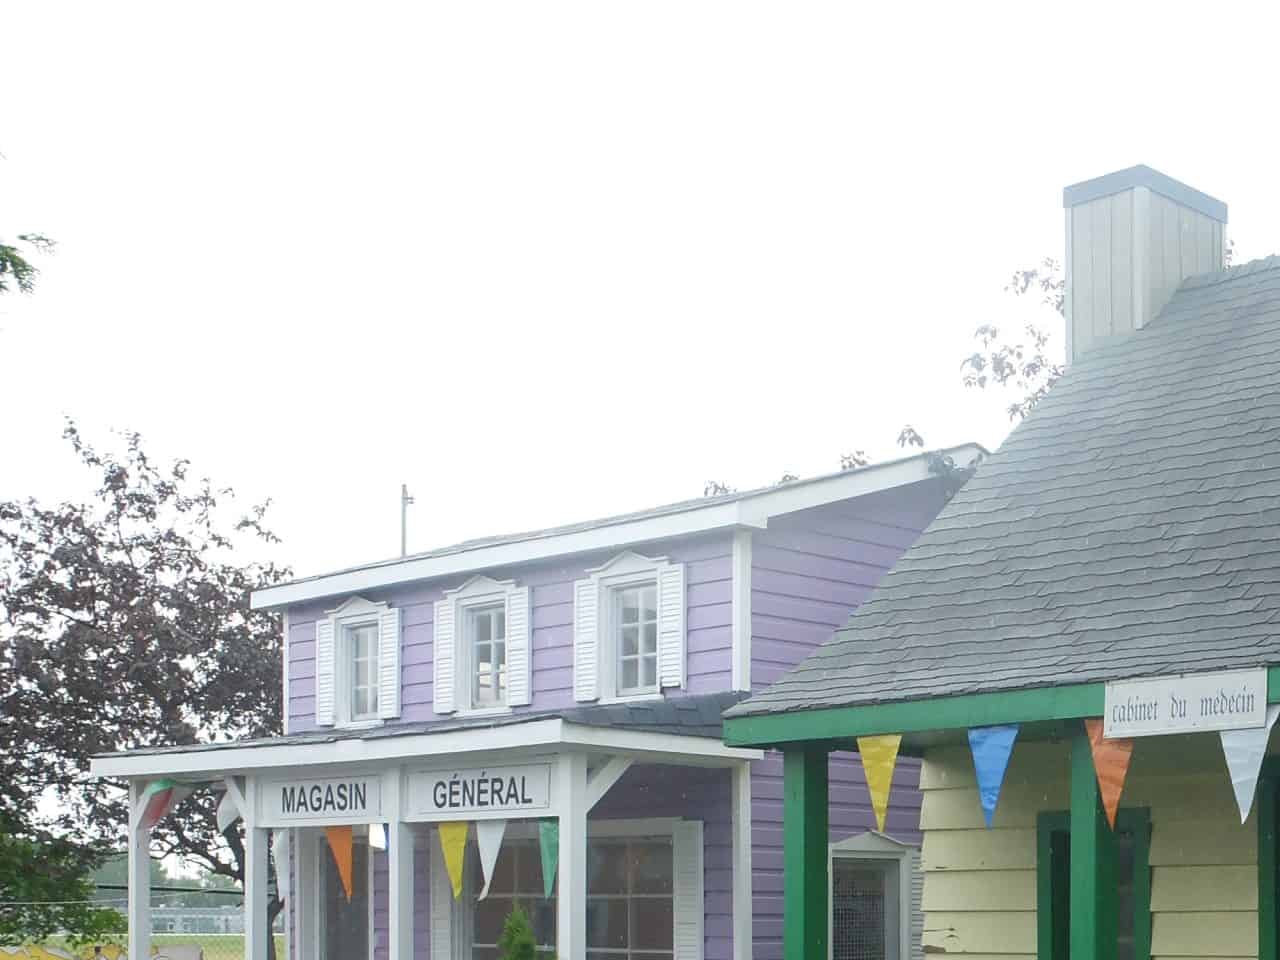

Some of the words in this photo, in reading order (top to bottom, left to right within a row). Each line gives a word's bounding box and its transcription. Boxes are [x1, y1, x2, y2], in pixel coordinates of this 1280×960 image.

[1112, 696, 1158, 722] cabinet
[1171, 691, 1186, 718] du
[281, 783, 367, 812] MAGASIN
[433, 771, 533, 808] GÉNÉRAL
